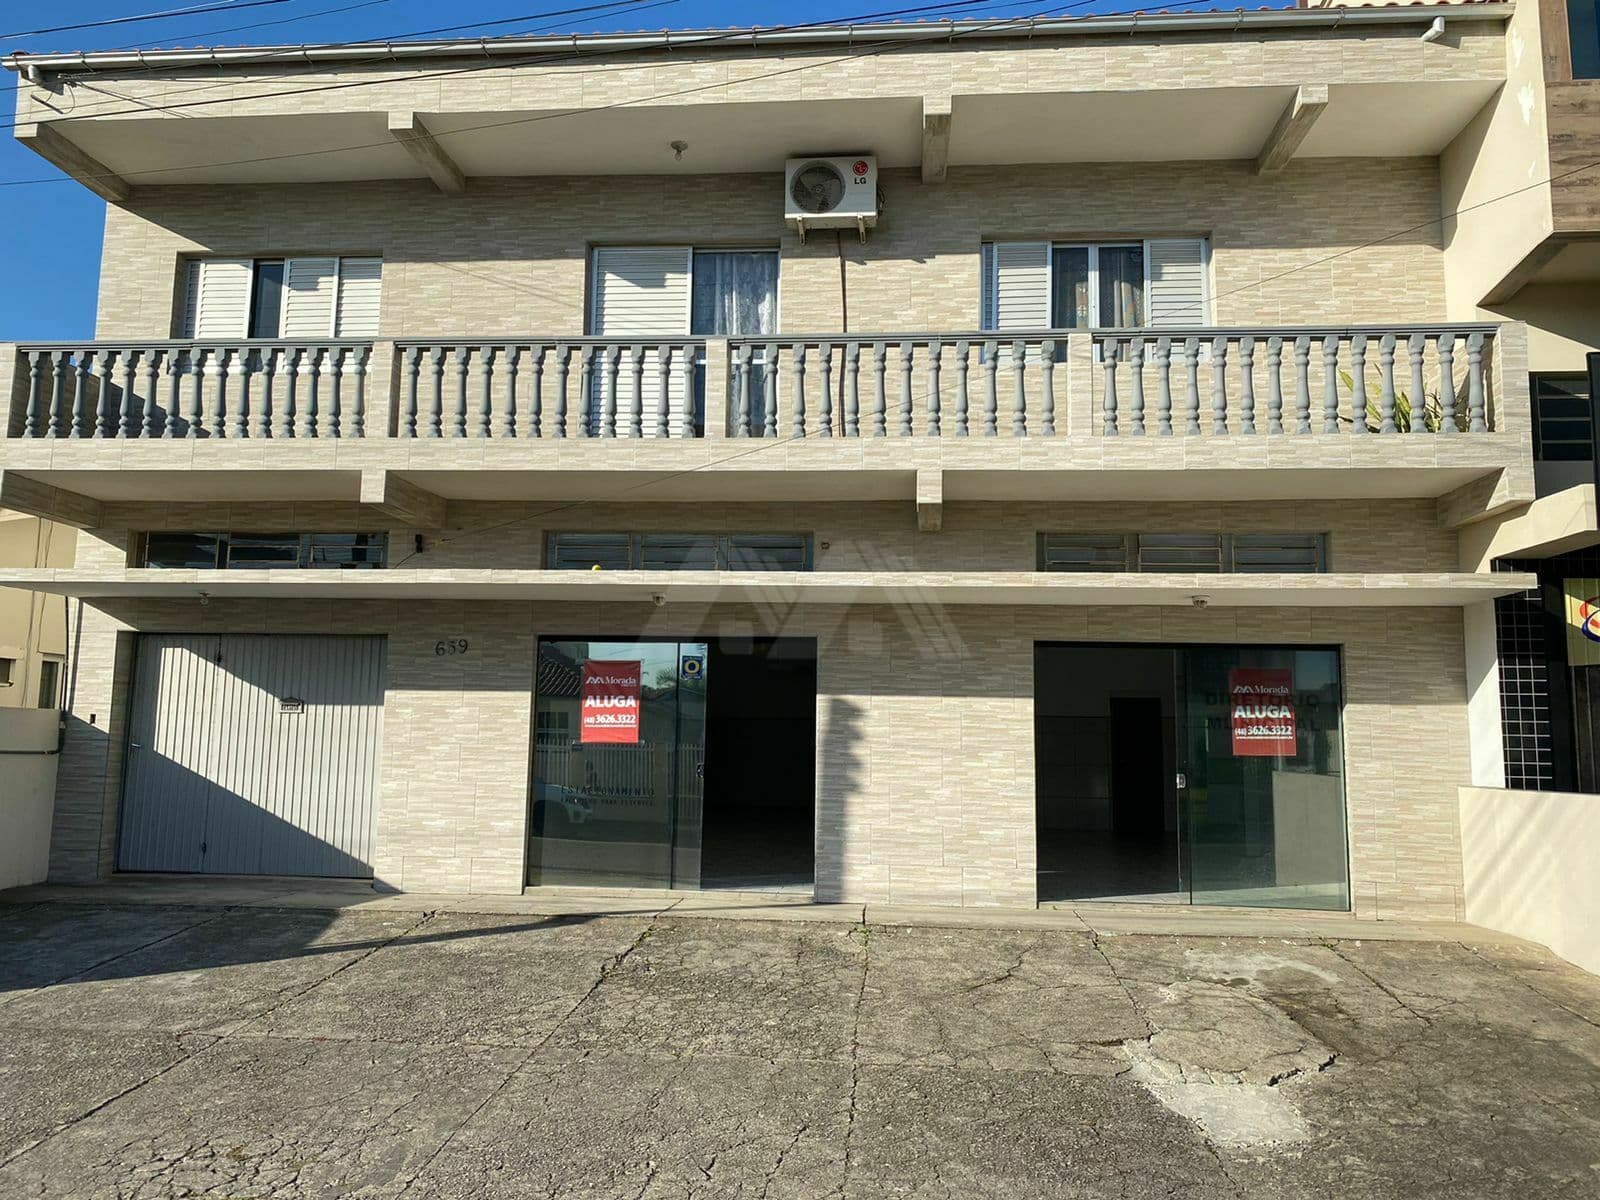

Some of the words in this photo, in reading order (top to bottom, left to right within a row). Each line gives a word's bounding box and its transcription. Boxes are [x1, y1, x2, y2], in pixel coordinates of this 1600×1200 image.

[854, 177, 866, 185] LG
[435, 639, 468, 656] 659
[605, 676, 636, 684] Morada
[1254, 685, 1289, 693] Morada
[585, 695, 636, 708] ALUGA
[1234, 705, 1291, 719] ALUGA
[595, 714, 636, 724] 3626.3322
[1247, 725, 1293, 736] 3626.3322
